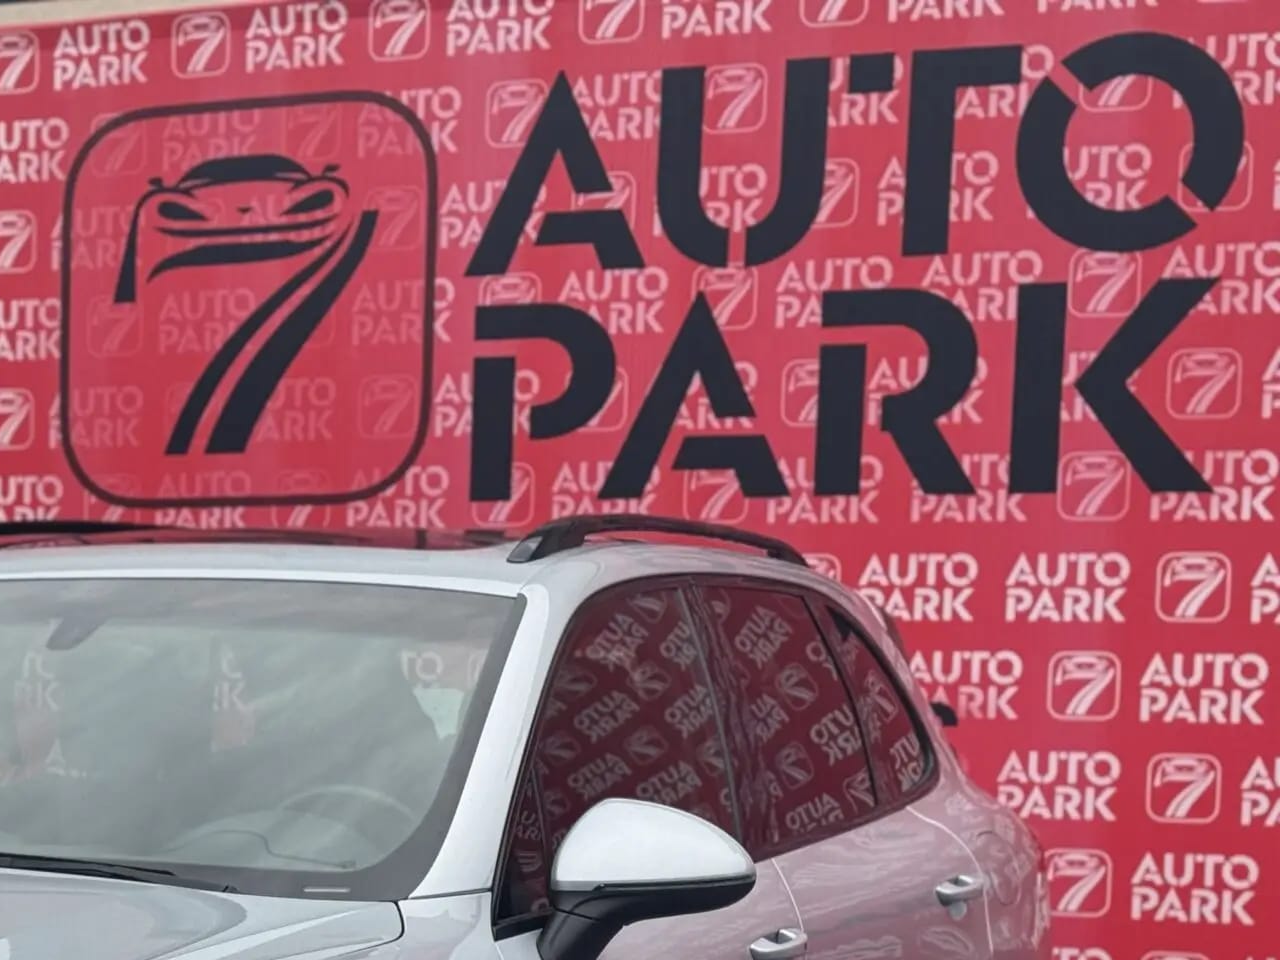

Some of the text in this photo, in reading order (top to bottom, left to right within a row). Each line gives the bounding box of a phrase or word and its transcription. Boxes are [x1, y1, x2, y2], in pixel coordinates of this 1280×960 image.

[247, 4, 347, 39] AUTO
[447, 15, 551, 56] PARK
[662, 2, 772, 39] PARK
[54, 20, 149, 58] AUTO
[246, 32, 344, 72] PARK
[54, 51, 146, 91] PARK
[465, 32, 1245, 277] AUTO
[1064, 143, 1152, 182] UTO
[558, 267, 668, 303] AUTO
[776, 256, 893, 293] AUTO
[921, 250, 1043, 287] AUTO
[159, 289, 256, 321] AUTO
[469, 277, 1220, 501] PARK
[257, 408, 333, 441] ARK
[347, 499, 447, 528] PARK
[766, 494, 880, 525] PARK
[910, 491, 1027, 525] PARK
[1149, 488, 1275, 523] PARK
[859, 552, 979, 588] AUTO
[1006, 553, 1130, 586] AUTO
[1006, 587, 1125, 622] PARK
[909, 649, 1023, 686] AUTO
[1140, 653, 1268, 688] AUTO
[1140, 688, 1263, 724] PARK
[997, 750, 1122, 787] AUTO
[1132, 853, 1259, 889] AUTO
[1131, 886, 1254, 925] PARK
